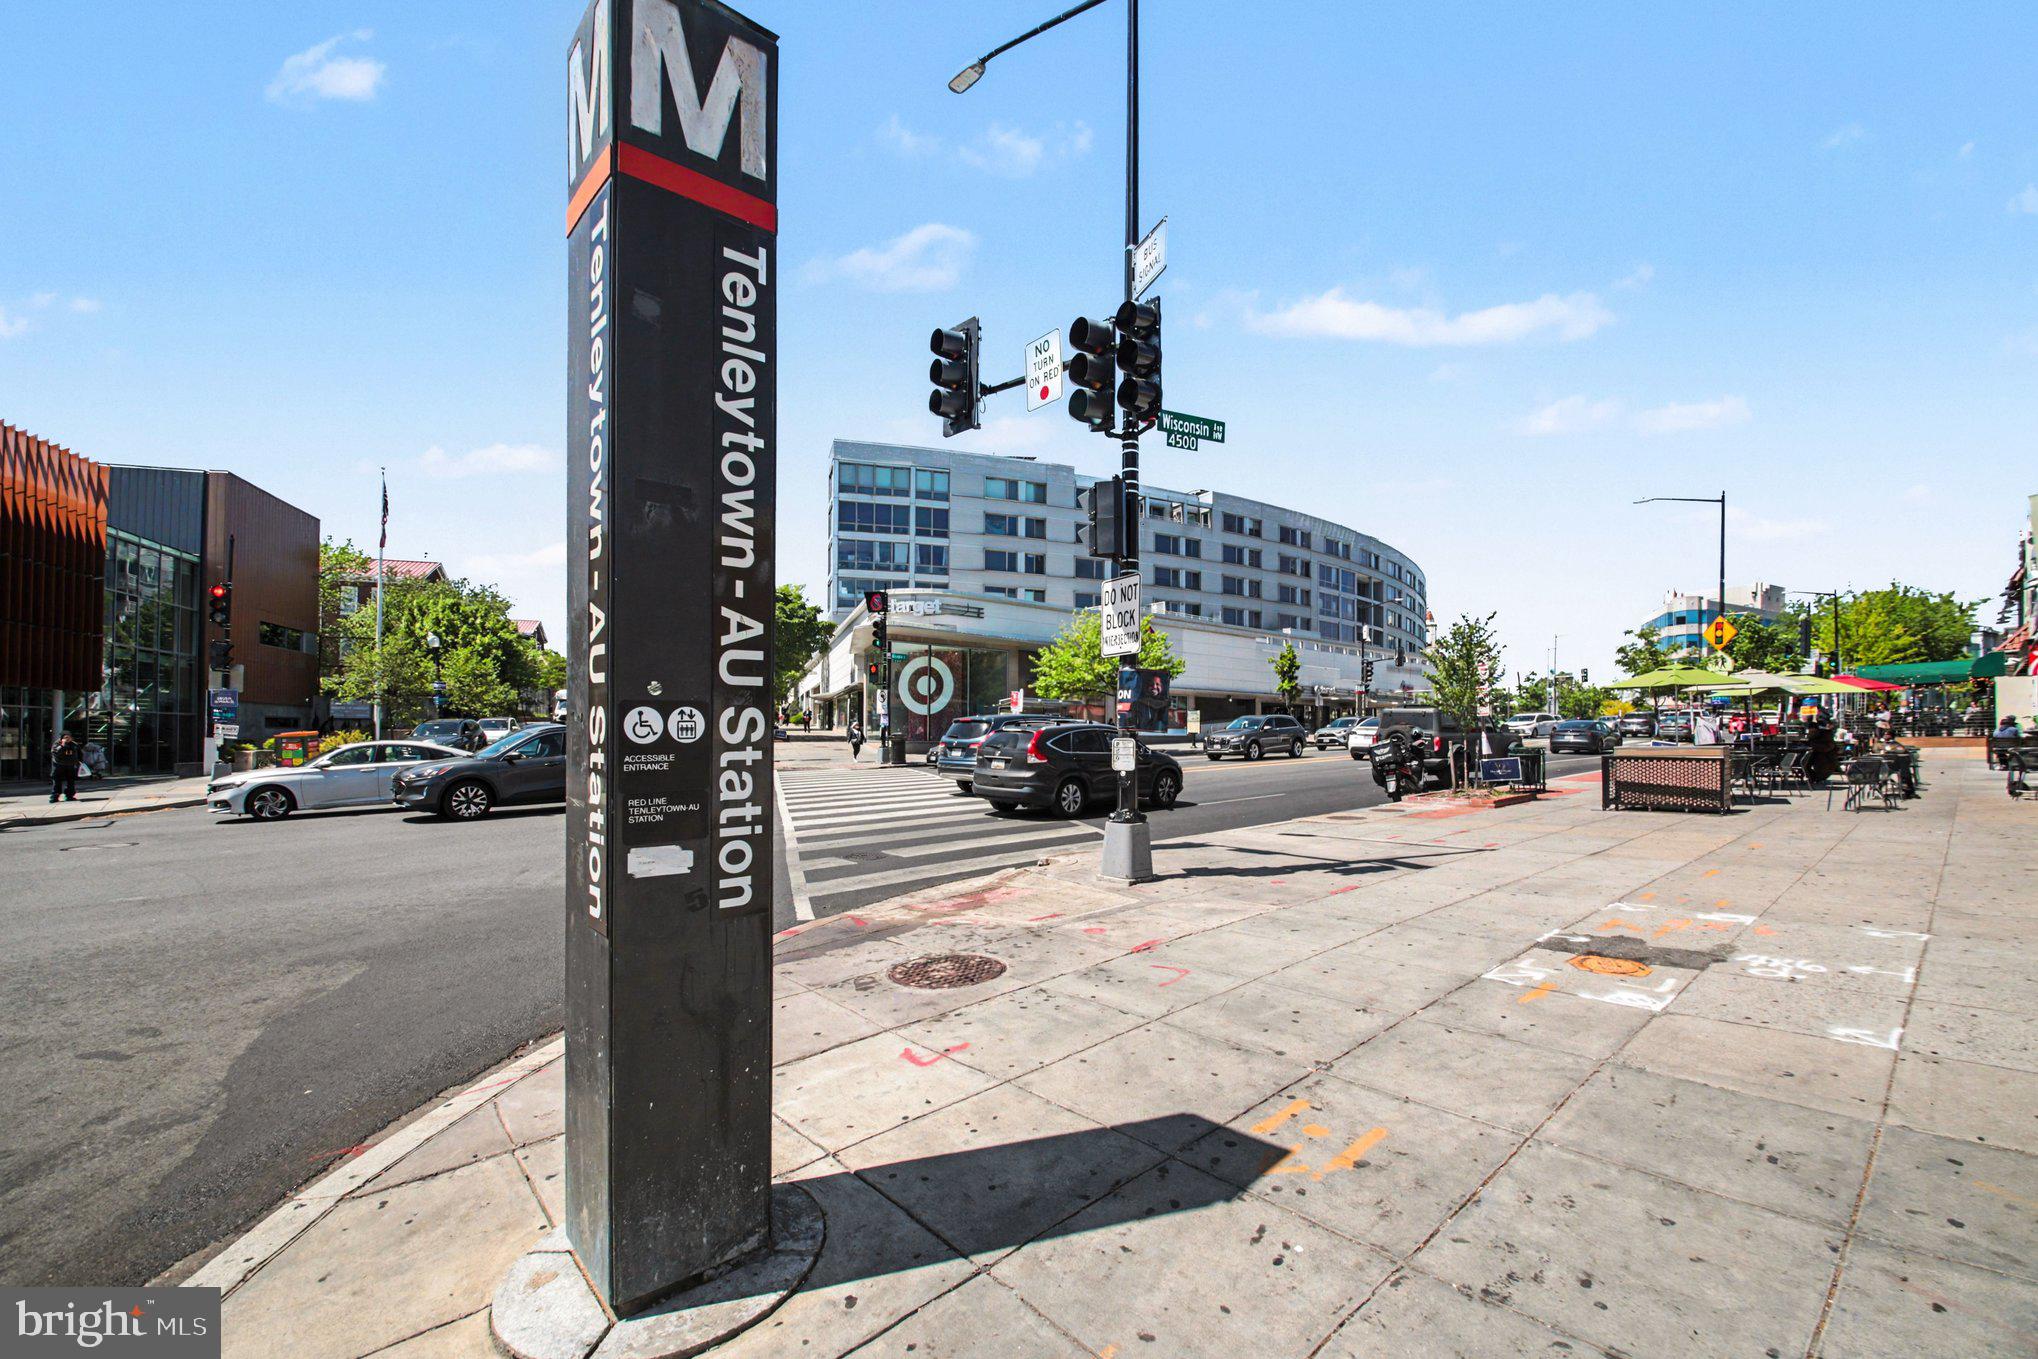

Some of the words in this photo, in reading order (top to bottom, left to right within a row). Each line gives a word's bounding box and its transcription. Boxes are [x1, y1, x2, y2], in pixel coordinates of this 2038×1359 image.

[569, 0, 609, 187] M
[631, 0, 767, 182] M
[1143, 238, 1158, 261] BUS
[1138, 253, 1162, 283] SIGNAL
[1035, 339, 1050, 358] NO
[1033, 353, 1054, 371] TURN
[1029, 372, 1040, 389] ON
[1044, 365, 1059, 383] RED
[1162, 413, 1209, 437] Wisconsin
[1168, 434, 1197, 450] 4500
[1104, 588, 1117, 606] DO
[1120, 583, 1138, 603] NOT
[888, 598, 942, 616] target
[1106, 609, 1136, 630] BLOCK
[623, 763, 669, 772] ENTRANCE
[624, 754, 675, 762] ACCESSIBLE
[588, 706, 606, 919] Station
[628, 799, 647, 807] RED
[648, 797, 667, 806] LINE
[629, 803, 700, 815] TENLEYTOWN-AU
[719, 707, 766, 909] Station
[628, 814, 664, 824] STATION
